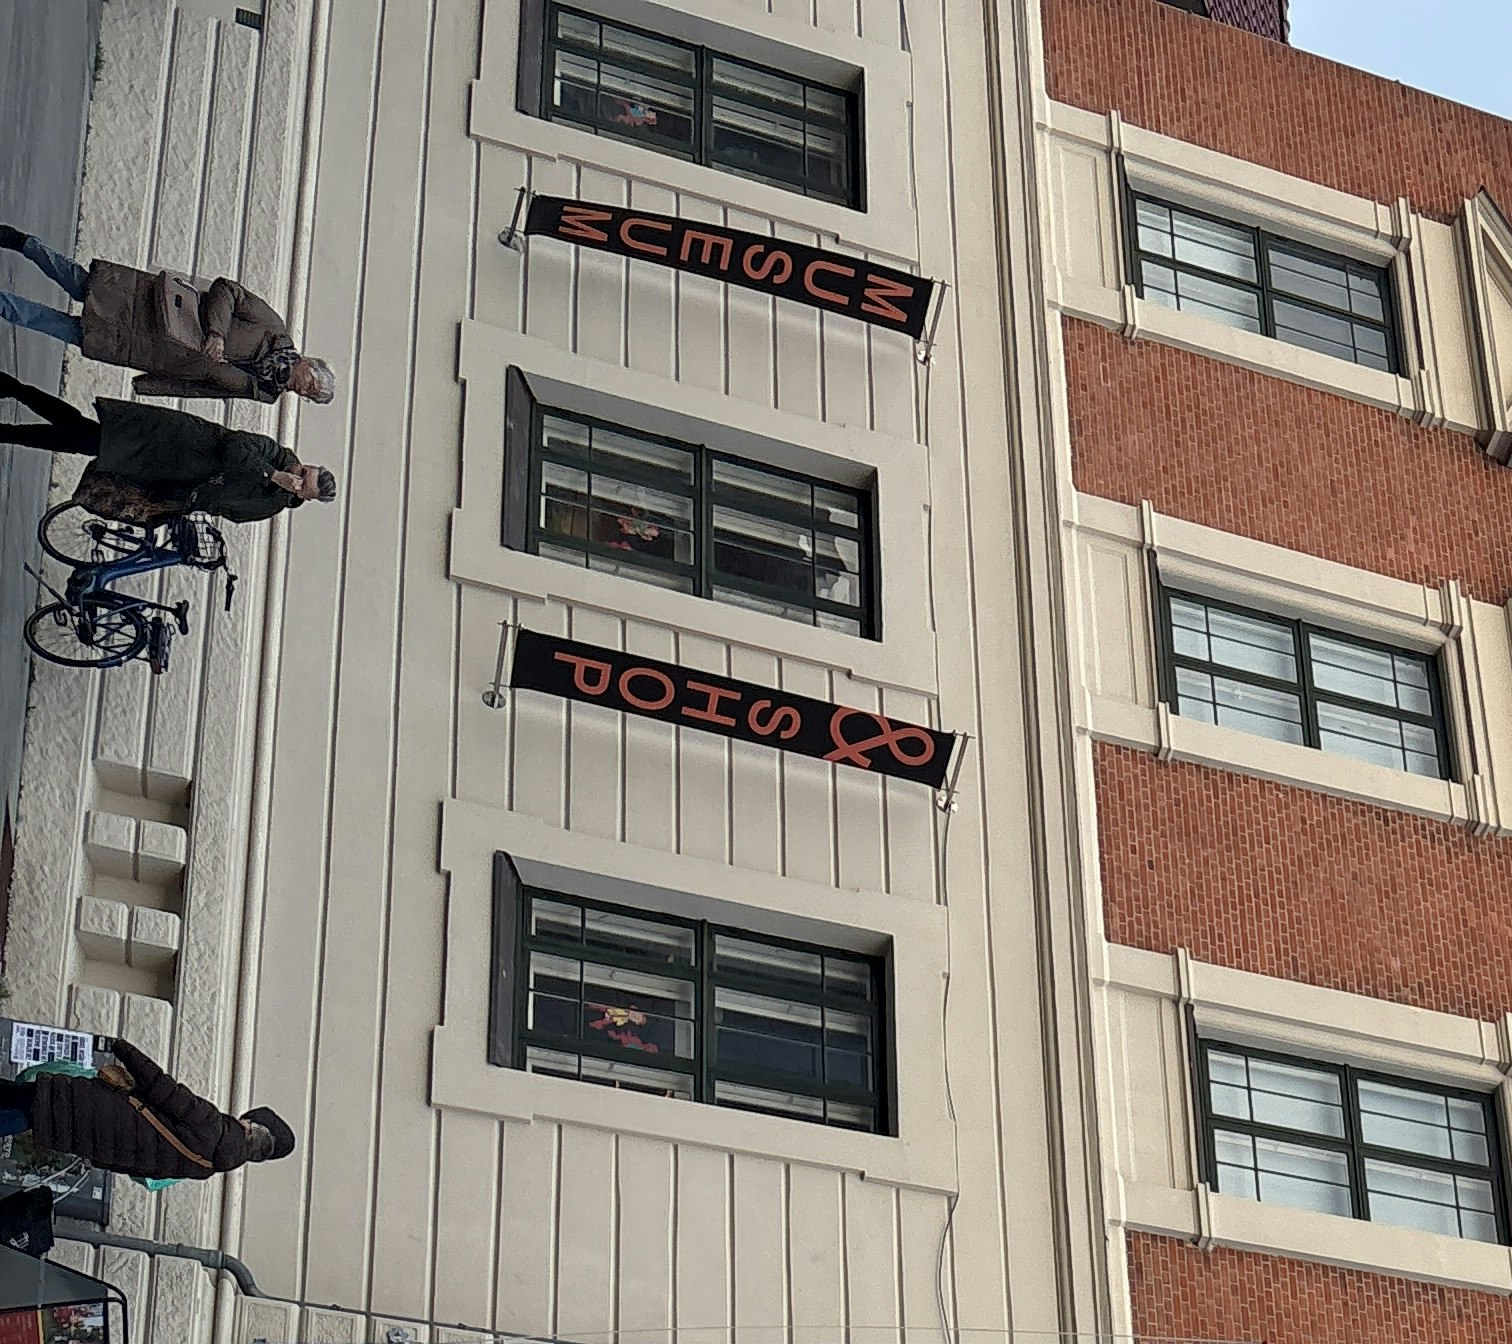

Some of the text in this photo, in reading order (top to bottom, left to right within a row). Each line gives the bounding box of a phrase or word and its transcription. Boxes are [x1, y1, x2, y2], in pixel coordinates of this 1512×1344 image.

[558, 205, 914, 322] MUSEUM
[553, 651, 935, 768] & SHOP
